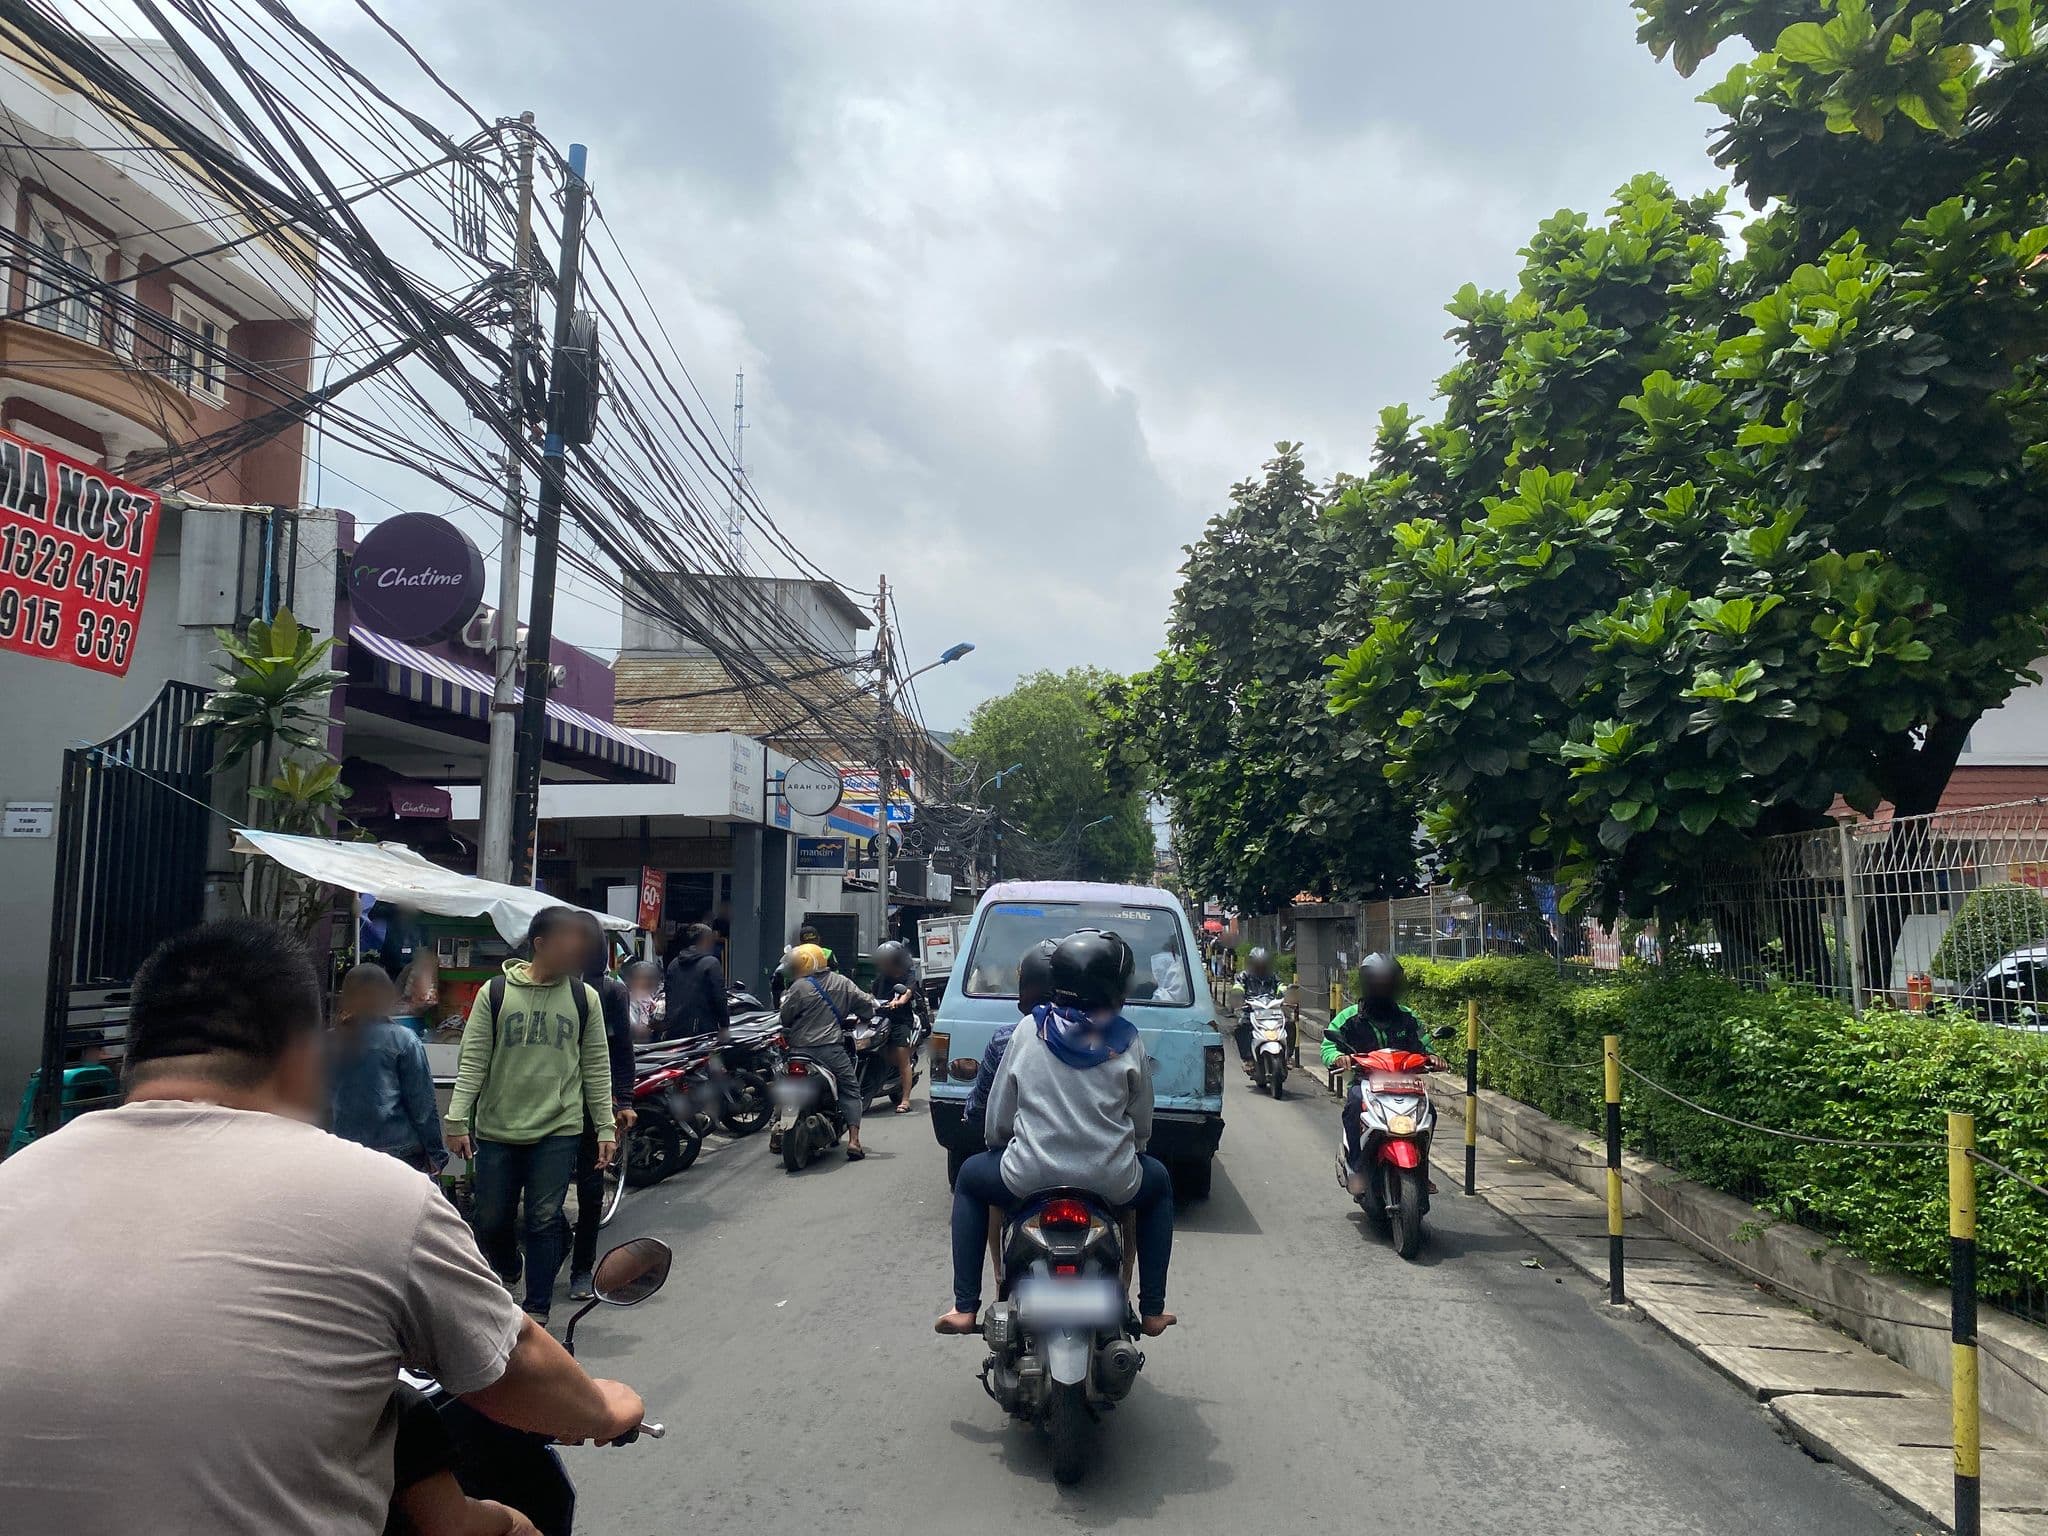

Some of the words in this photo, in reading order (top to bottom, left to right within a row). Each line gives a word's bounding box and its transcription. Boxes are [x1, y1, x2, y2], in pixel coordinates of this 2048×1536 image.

[53, 462, 153, 556] KOST
[0, 522, 75, 592] 1323
[75, 551, 142, 612] 4154
[377, 566, 463, 588] Chatime
[76, 609, 131, 667] 333
[401, 801, 440, 814] Chatime
[504, 1010, 575, 1050] GAP
